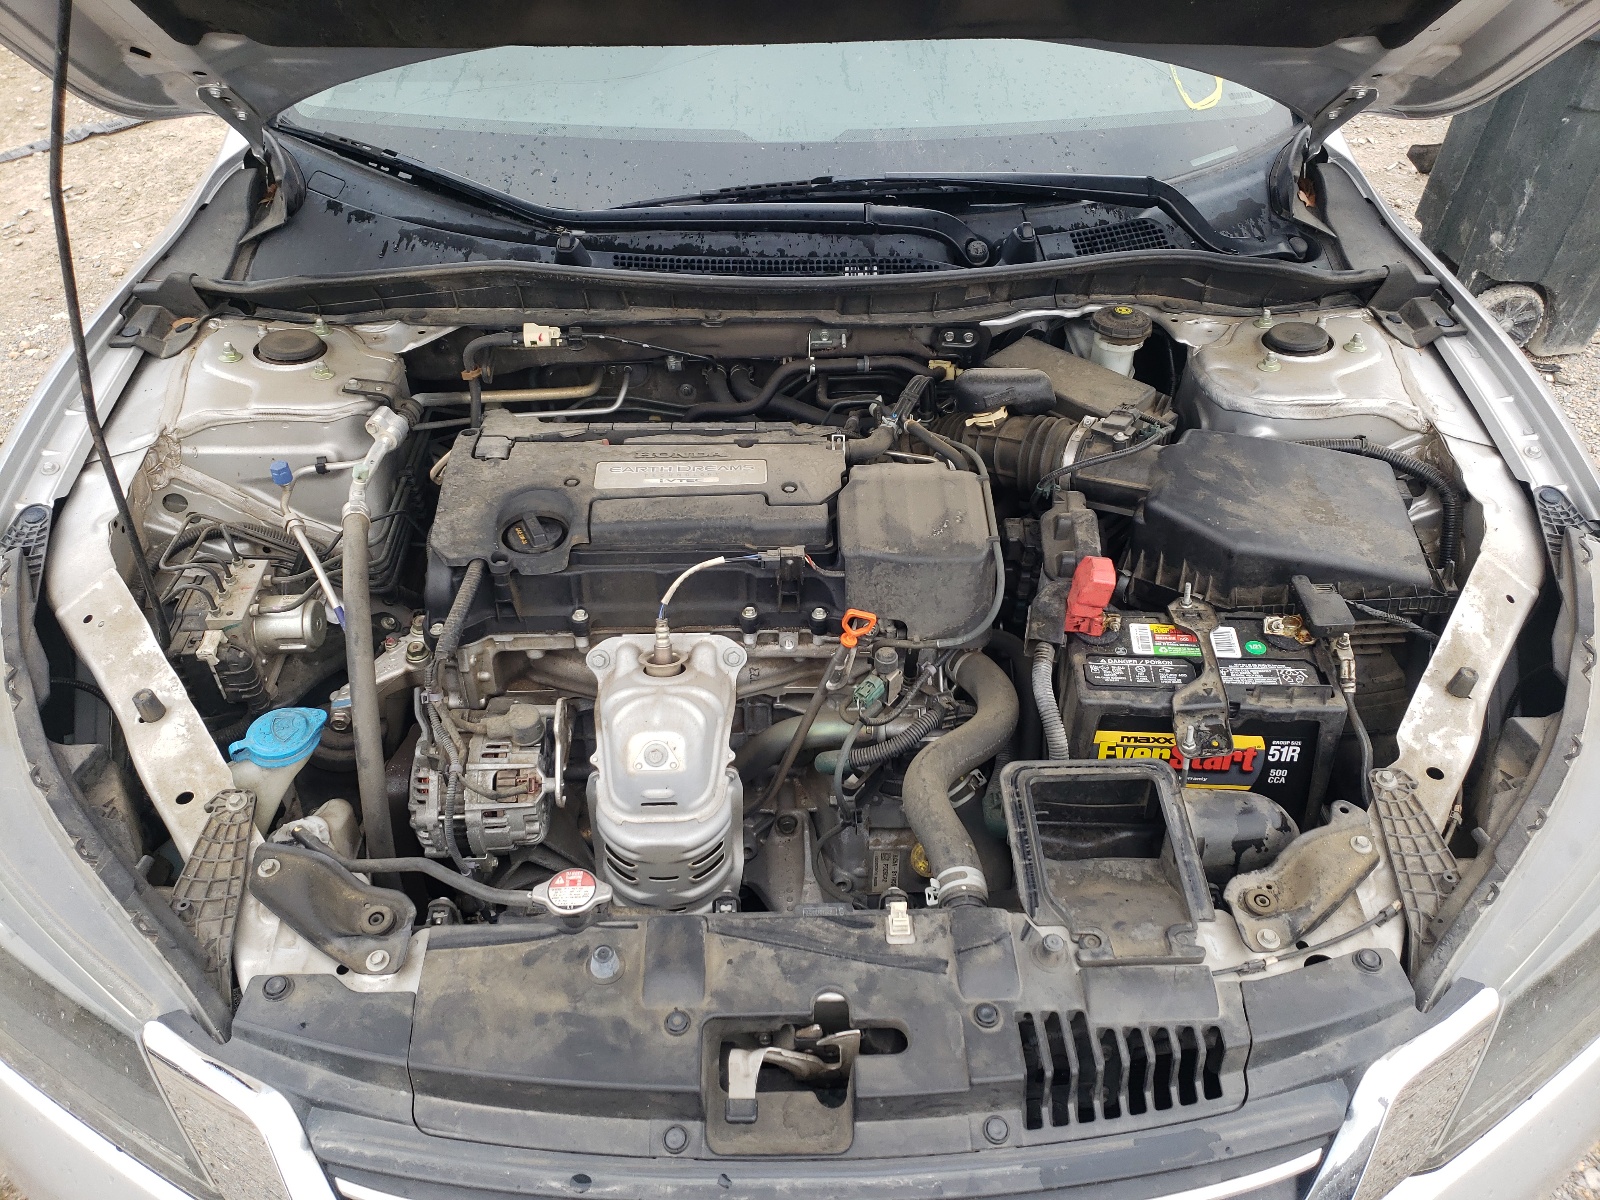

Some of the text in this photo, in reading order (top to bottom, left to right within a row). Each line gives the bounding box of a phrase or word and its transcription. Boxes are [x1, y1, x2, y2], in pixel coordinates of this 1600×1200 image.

[677, 464, 755, 472] DREAMS
[1120, 735, 1175, 745] maxx
[1267, 745, 1301, 762] 51R
[1269, 769, 1288, 777] 500
[1267, 776, 1286, 784] CCA
